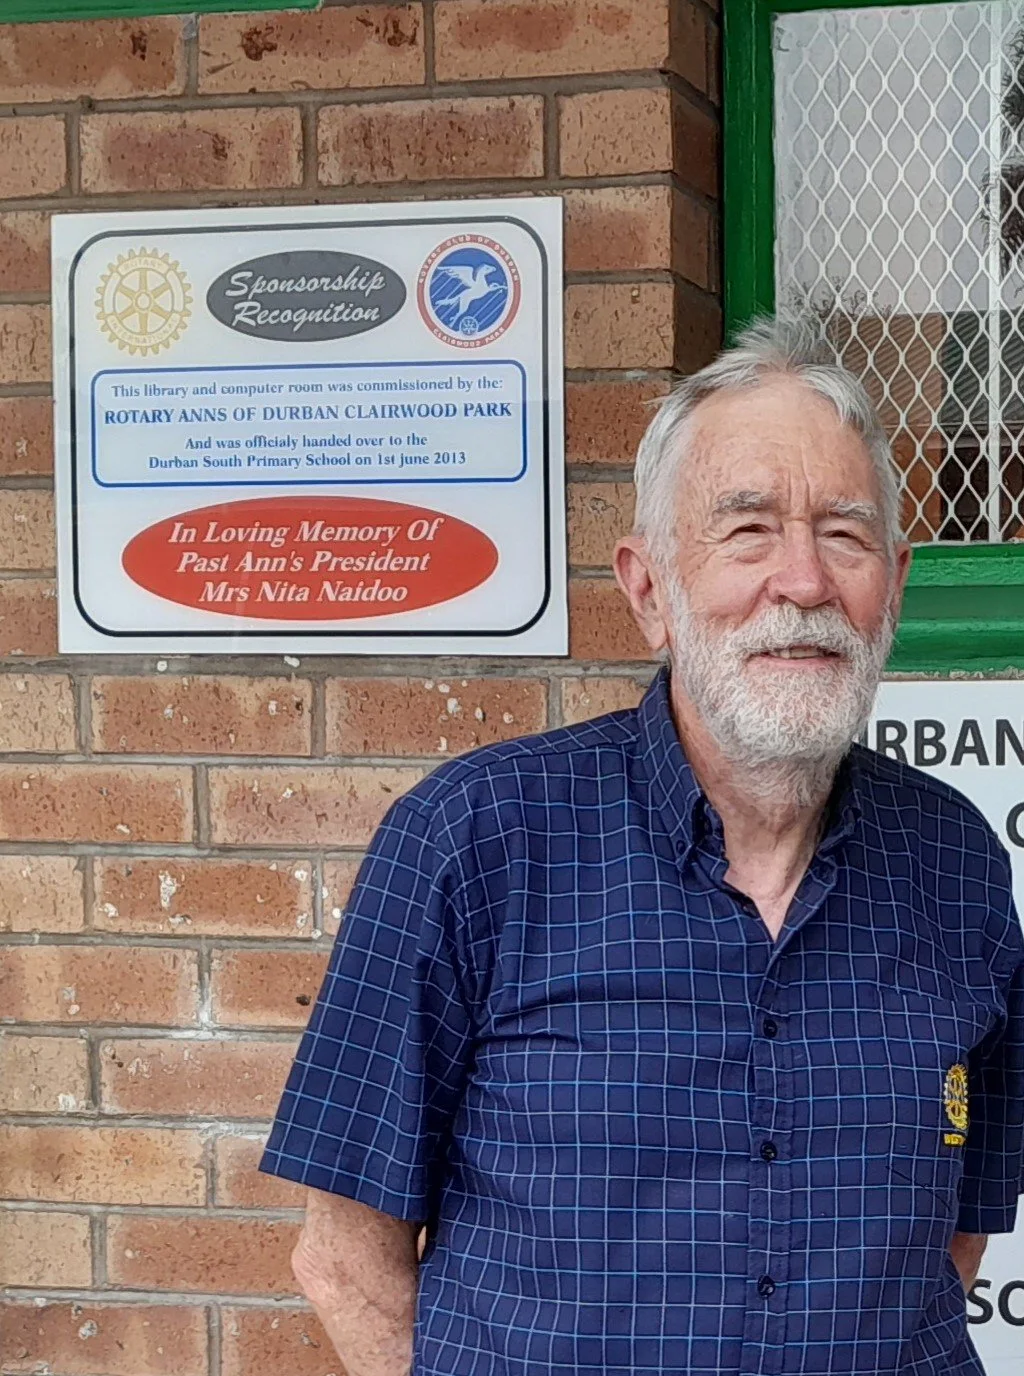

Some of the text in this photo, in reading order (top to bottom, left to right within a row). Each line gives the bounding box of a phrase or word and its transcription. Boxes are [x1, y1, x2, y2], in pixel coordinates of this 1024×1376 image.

[225, 265, 386, 299] Sponsorship
[232, 301, 380, 332] Recognition
[111, 376, 503, 399] This library and computer room was commissioned by the:
[104, 402, 512, 424] ROTARY ANNS OF DURBAN CLAIRWOOD PARK
[185, 433, 428, 451] And was officialy handed over to the
[149, 455, 199, 469] Durban
[203, 454, 242, 468] South
[247, 454, 301, 470] Primary
[305, 452, 351, 466] School
[355, 456, 372, 466] on
[378, 453, 396, 465] 1st
[434, 452, 466, 465] 2013
[168, 518, 445, 547] In Loving Memory Of
[176, 549, 431, 572] Past Ann's President
[198, 579, 408, 602] Mrs Nita Naidoo
